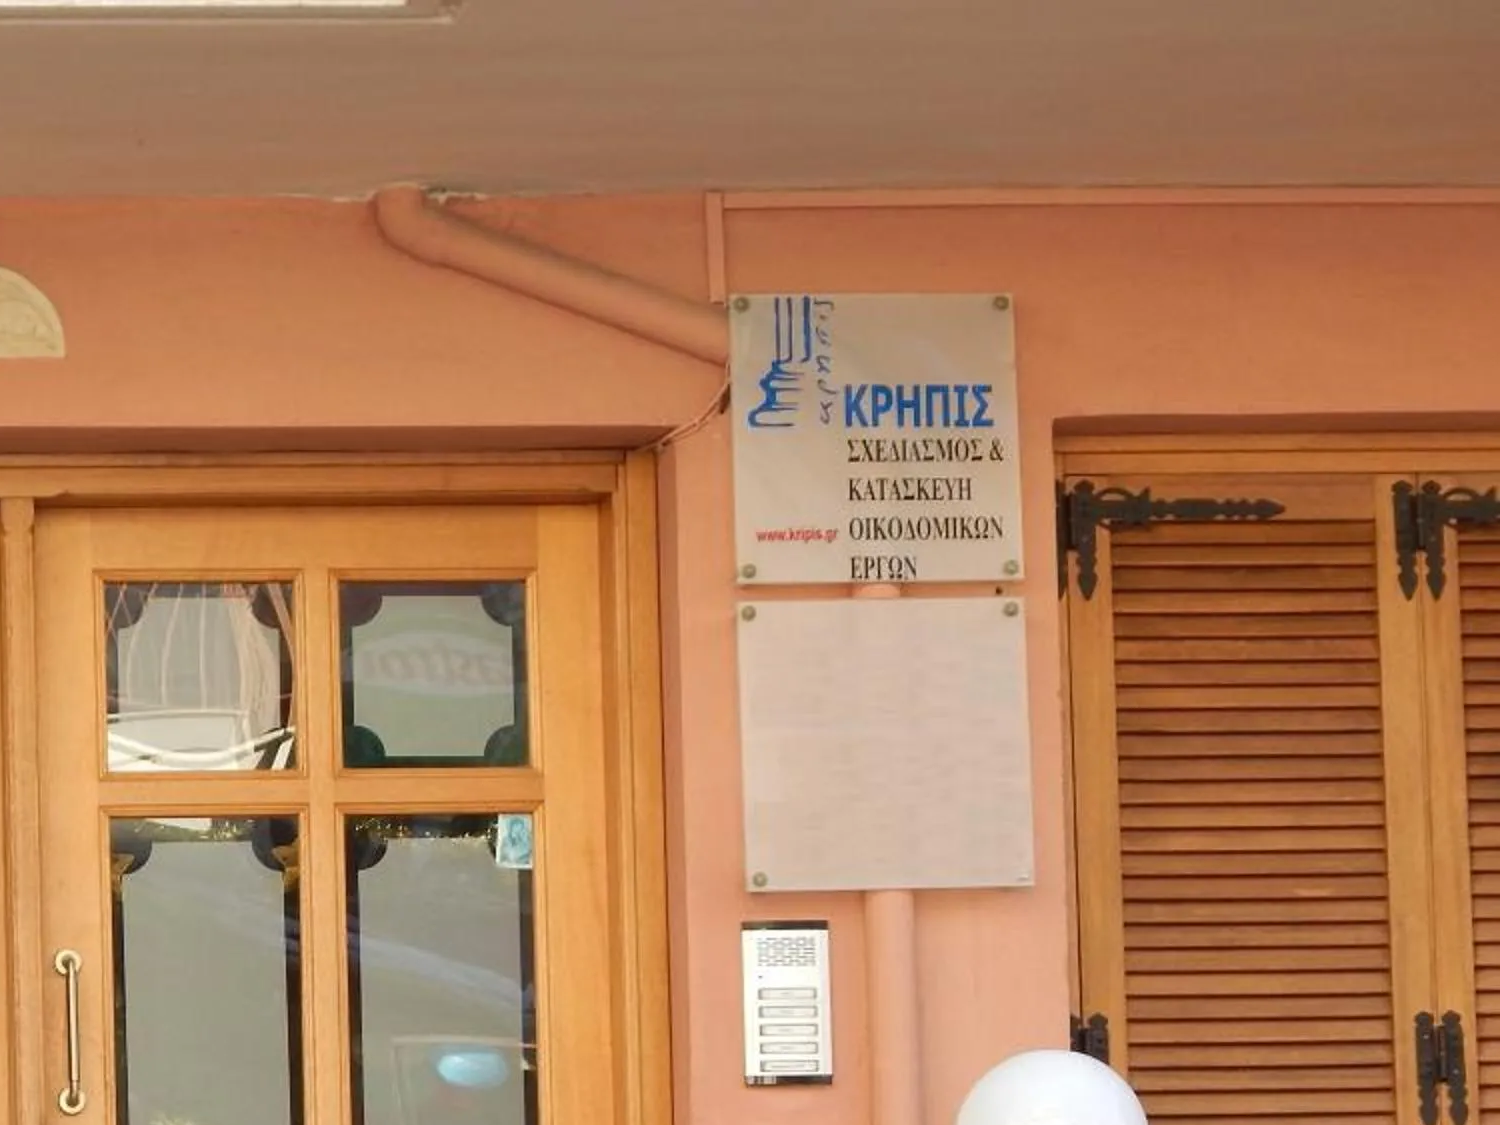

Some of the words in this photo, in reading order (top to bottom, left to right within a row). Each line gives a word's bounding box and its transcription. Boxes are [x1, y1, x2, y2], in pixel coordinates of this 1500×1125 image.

[845, 383, 994, 427] ΚΡΗΠΙΣ
[847, 437, 983, 462] ΣΧΕΔΙΑΣΜΟΣ
[989, 437, 1004, 461] &
[848, 477, 972, 501] ΚΑΤΑΣΚΕΥΗ
[755, 528, 839, 544] www.kripis.gr
[849, 516, 1004, 541] ΟΙΚΟΔΟΜΙΚΩΝ
[850, 556, 917, 580] ΕΡΓΩΝ
